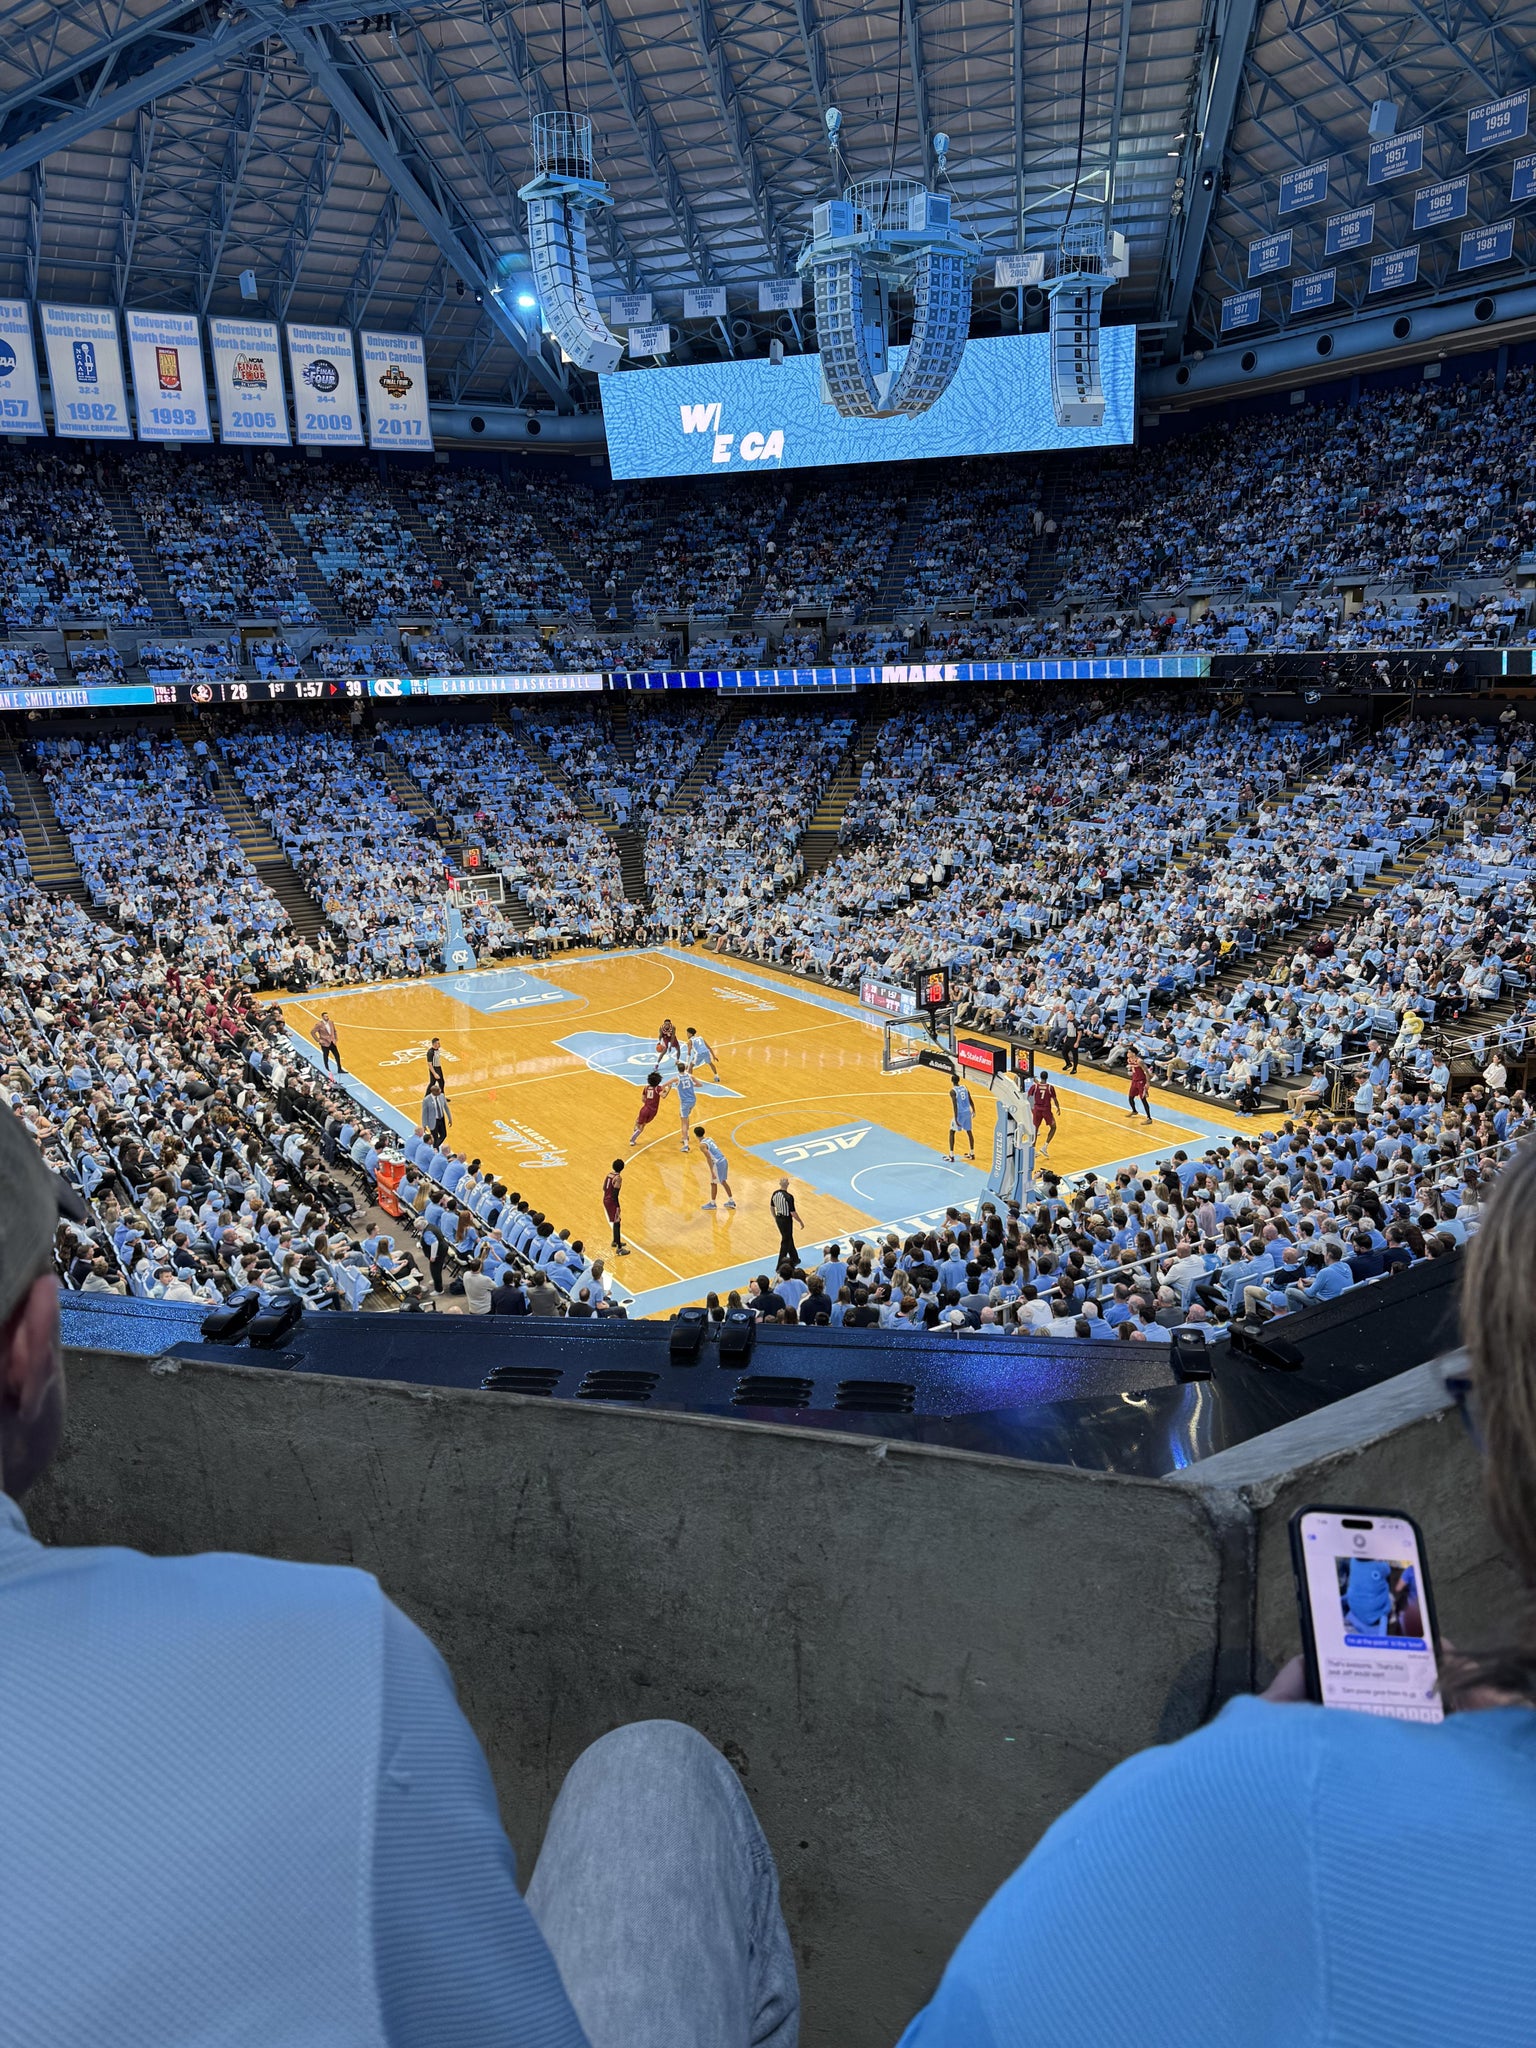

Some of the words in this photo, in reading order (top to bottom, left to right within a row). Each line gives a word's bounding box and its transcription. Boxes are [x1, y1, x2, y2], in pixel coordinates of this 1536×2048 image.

[1470, 108, 1484, 120] ACC
[1486, 94, 1527, 116] CHAMPIONS
[1485, 112, 1511, 131] 1959
[1372, 144, 1384, 154] ACC
[1384, 130, 1422, 150] CHAMPIONS
[1385, 147, 1406, 164] 1957
[1417, 190, 1430, 200] ACC
[1430, 178, 1466, 196] CHAMPIONS
[1463, 232, 1476, 242] ACC
[1476, 222, 1512, 240] CHAMPIONS
[48, 308, 98, 324] University
[101, 313, 111, 324] of
[133, 315, 180, 332] University
[183, 320, 193, 331] of
[0, 322, 30, 334] rolina
[46, 324, 74, 338] North
[74, 326, 116, 340] Carolina
[216, 322, 261, 338] University
[264, 327, 272, 338] of
[292, 328, 336, 342] University
[338, 332, 346, 342] of
[132, 331, 158, 344] North
[158, 334, 198, 346] Carolina
[214, 337, 239, 350] North
[240, 340, 277, 352] Carolina
[367, 336, 408, 350] University
[410, 340, 418, 350] of
[291, 342, 314, 354] North
[316, 344, 351, 356] Carolina
[365, 350, 387, 362] North
[388, 351, 422, 364] Carolina
[0, 400, 29, 418] 57
[66, 402, 118, 421] 1982
[150, 408, 196, 425] 1993
[232, 411, 276, 428] 2005
[305, 413, 352, 430] 2009
[378, 418, 422, 435] 2017
[882, 664, 960, 684] MAKE
[230, 684, 248, 700] 28
[268, 682, 284, 698] 1ST
[296, 682, 324, 698] 1:57
[346, 681, 362, 696] 39
[442, 679, 508, 692] CAROLINA
[514, 676, 590, 690] BASKETBALL
[14, 692, 22, 707] E.
[25, 691, 53, 708] SMITH
[56, 690, 89, 706] CENTER
[682, 1080, 690, 1089] 13
[1040, 1090, 1046, 1100] 7
[774, 1127, 872, 1165] ACC
